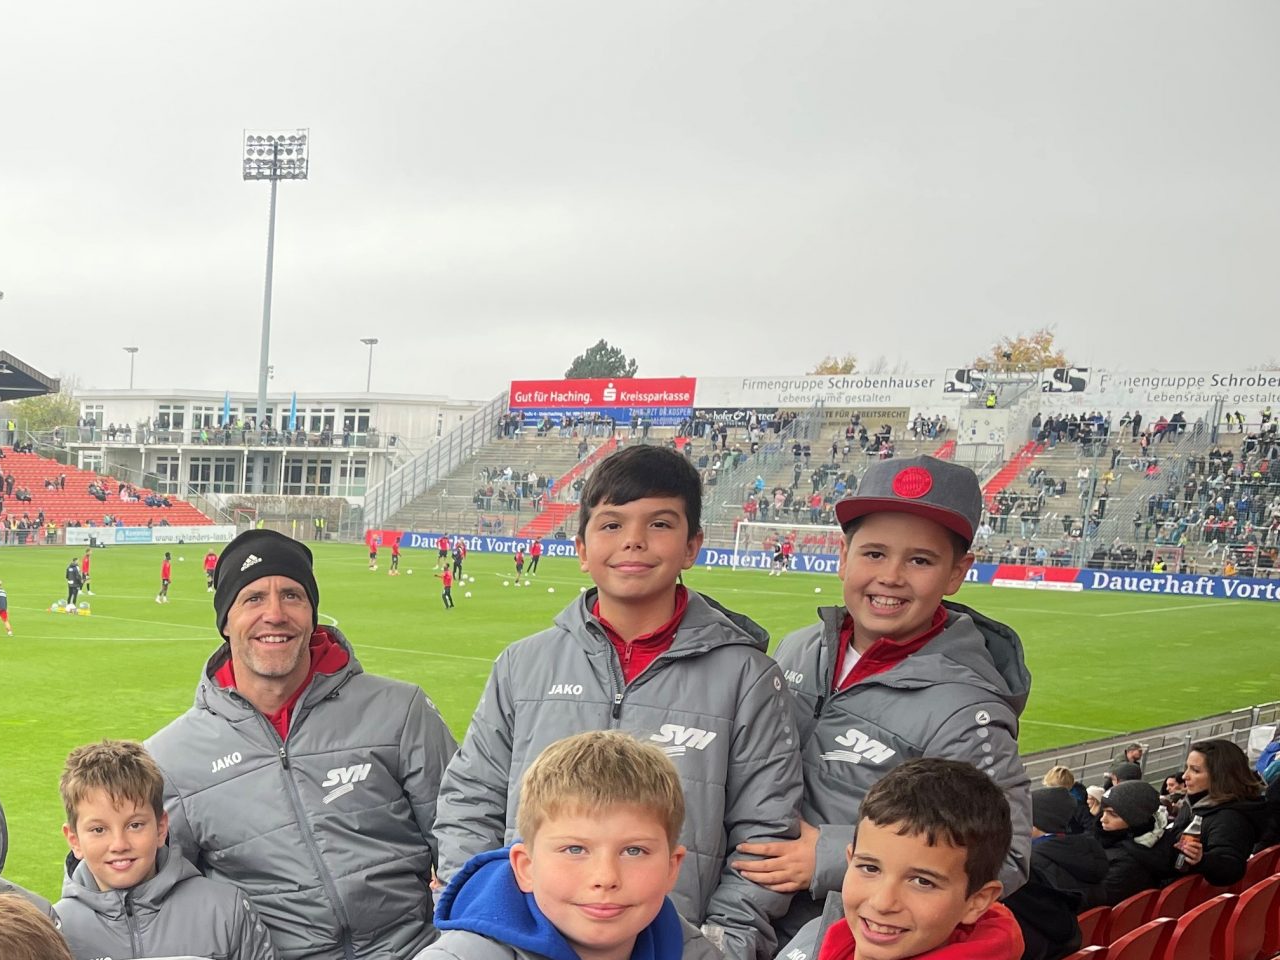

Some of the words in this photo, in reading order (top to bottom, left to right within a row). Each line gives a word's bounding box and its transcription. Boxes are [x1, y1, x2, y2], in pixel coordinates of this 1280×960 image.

[742, 377, 824, 391] Firmengruppe
[827, 376, 936, 390] Schrobenhauser
[515, 392, 532, 403] Gut
[535, 391, 547, 403] für
[550, 390, 593, 406] Haching.
[620, 391, 690, 404] Kreissparkasse
[845, 393, 891, 405] gestalten
[1092, 572, 1215, 596] Dauerhaft
[548, 684, 583, 695] JAKO
[211, 751, 242, 773] JAKO
